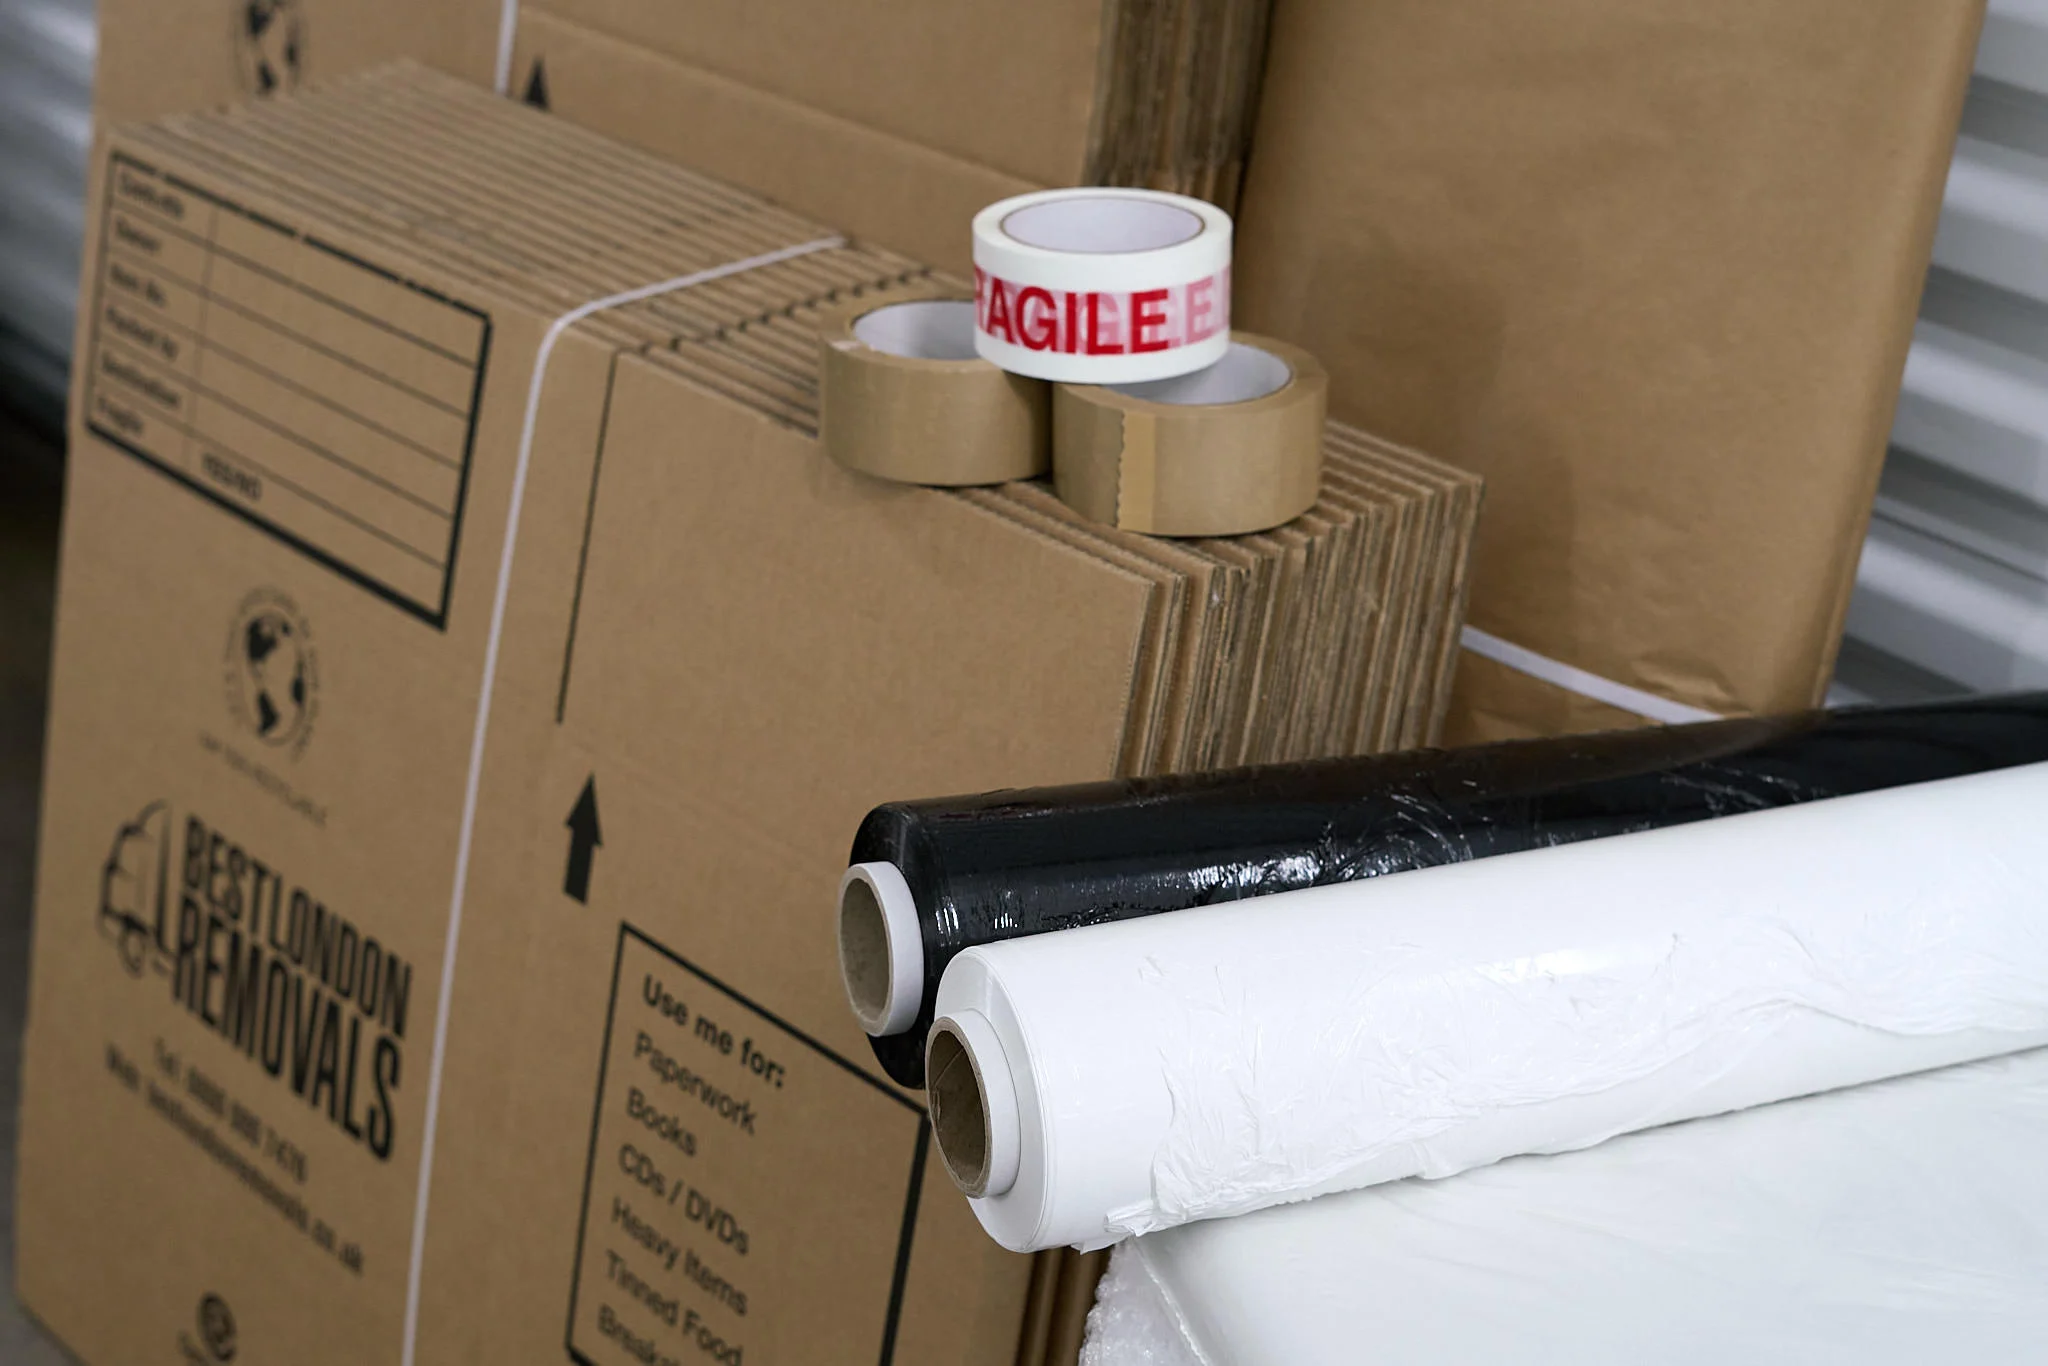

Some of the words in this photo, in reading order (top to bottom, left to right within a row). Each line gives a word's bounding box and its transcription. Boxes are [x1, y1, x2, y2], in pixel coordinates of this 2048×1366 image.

[174, 894, 402, 1160] REMOVALS
[634, 1031, 757, 1136] Paperwork
[643, 974, 689, 1026] Use
[694, 1014, 733, 1055] me
[741, 1038, 786, 1089] for:
[626, 1086, 697, 1157] Books
[611, 1196, 679, 1271] Heavy
[685, 1250, 748, 1317] Items
[619, 1143, 666, 1197] CDs
[685, 1187, 749, 1256] DVDs
[606, 1249, 679, 1327] Tinned
[682, 1309, 744, 1366] Food
